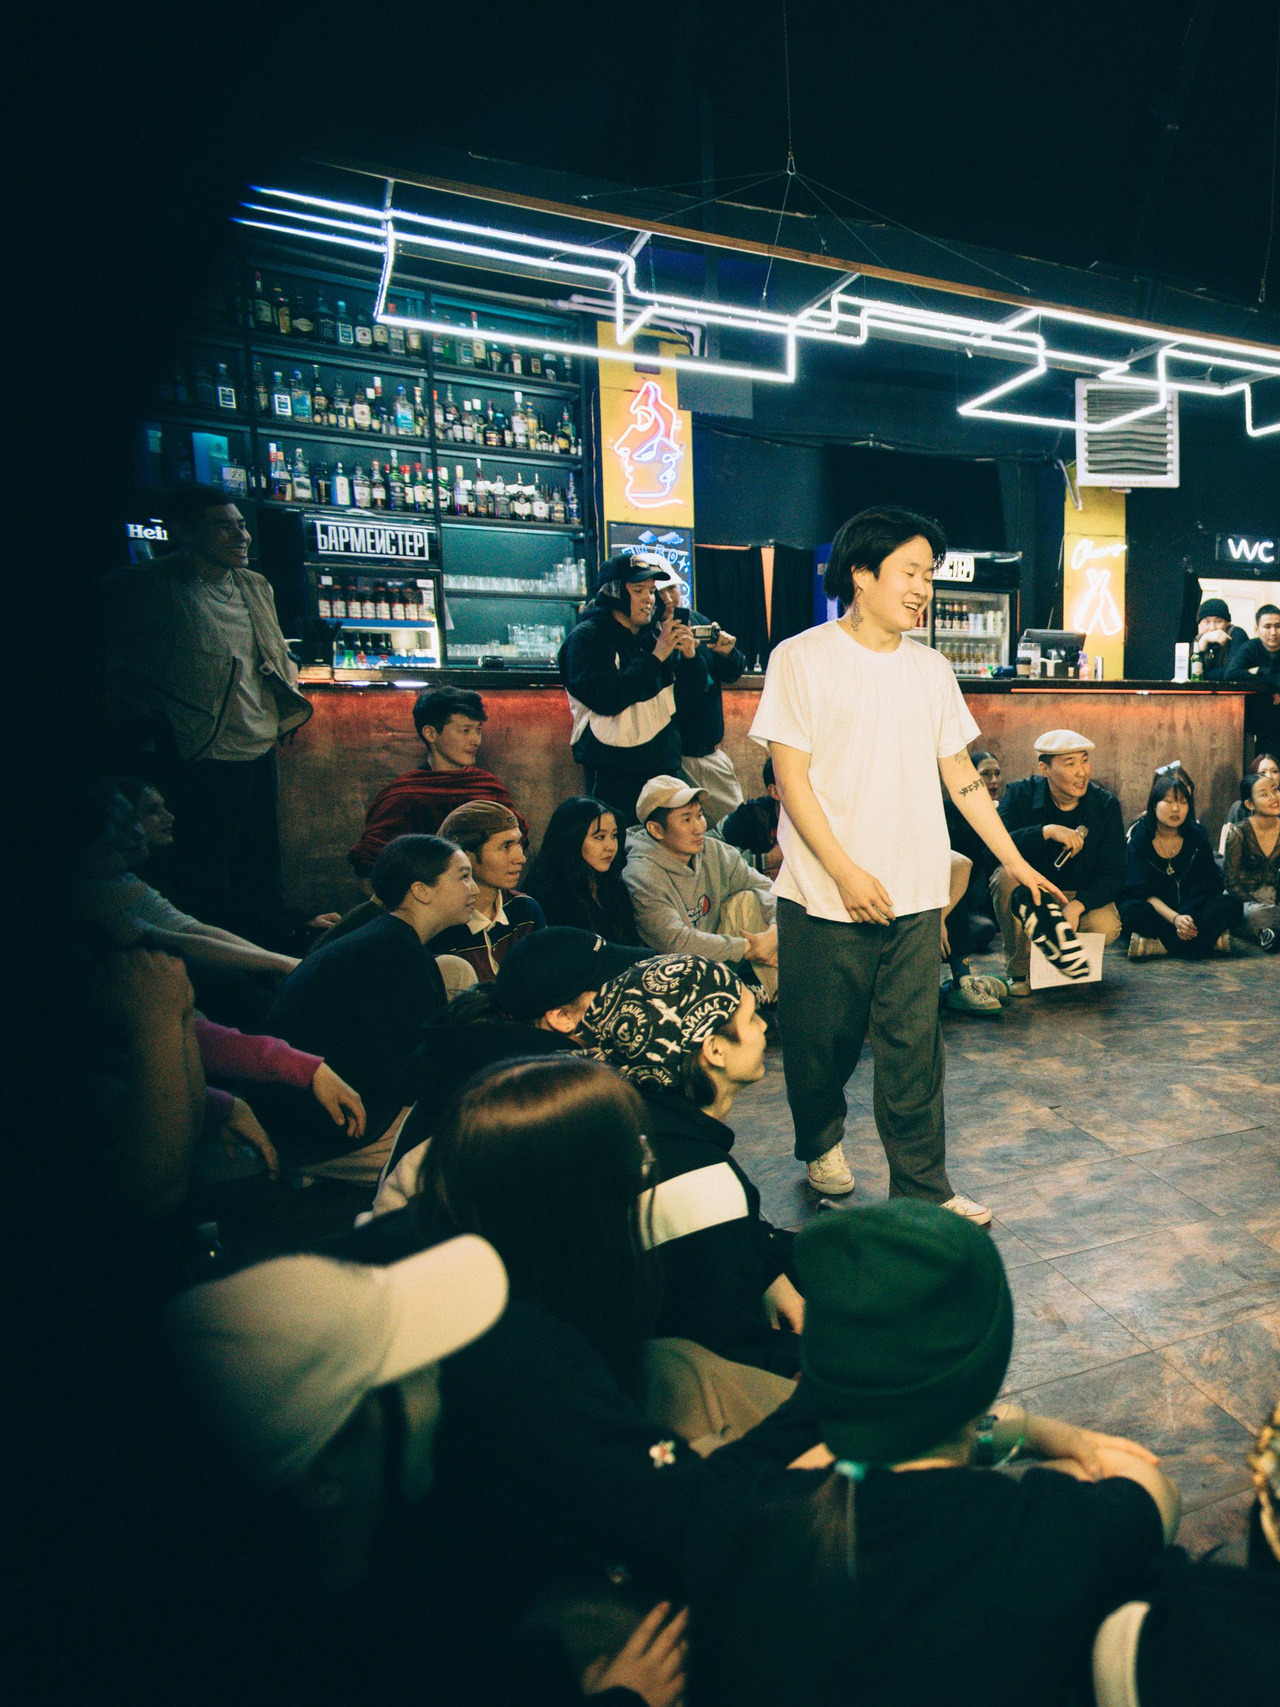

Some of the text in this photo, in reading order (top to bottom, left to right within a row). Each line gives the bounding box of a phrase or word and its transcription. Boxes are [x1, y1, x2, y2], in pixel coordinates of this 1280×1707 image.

[1227, 538, 1274, 563] WC
[620, 1004, 648, 1027] BAIKAL
[652, 1068, 673, 1086] BAIK
